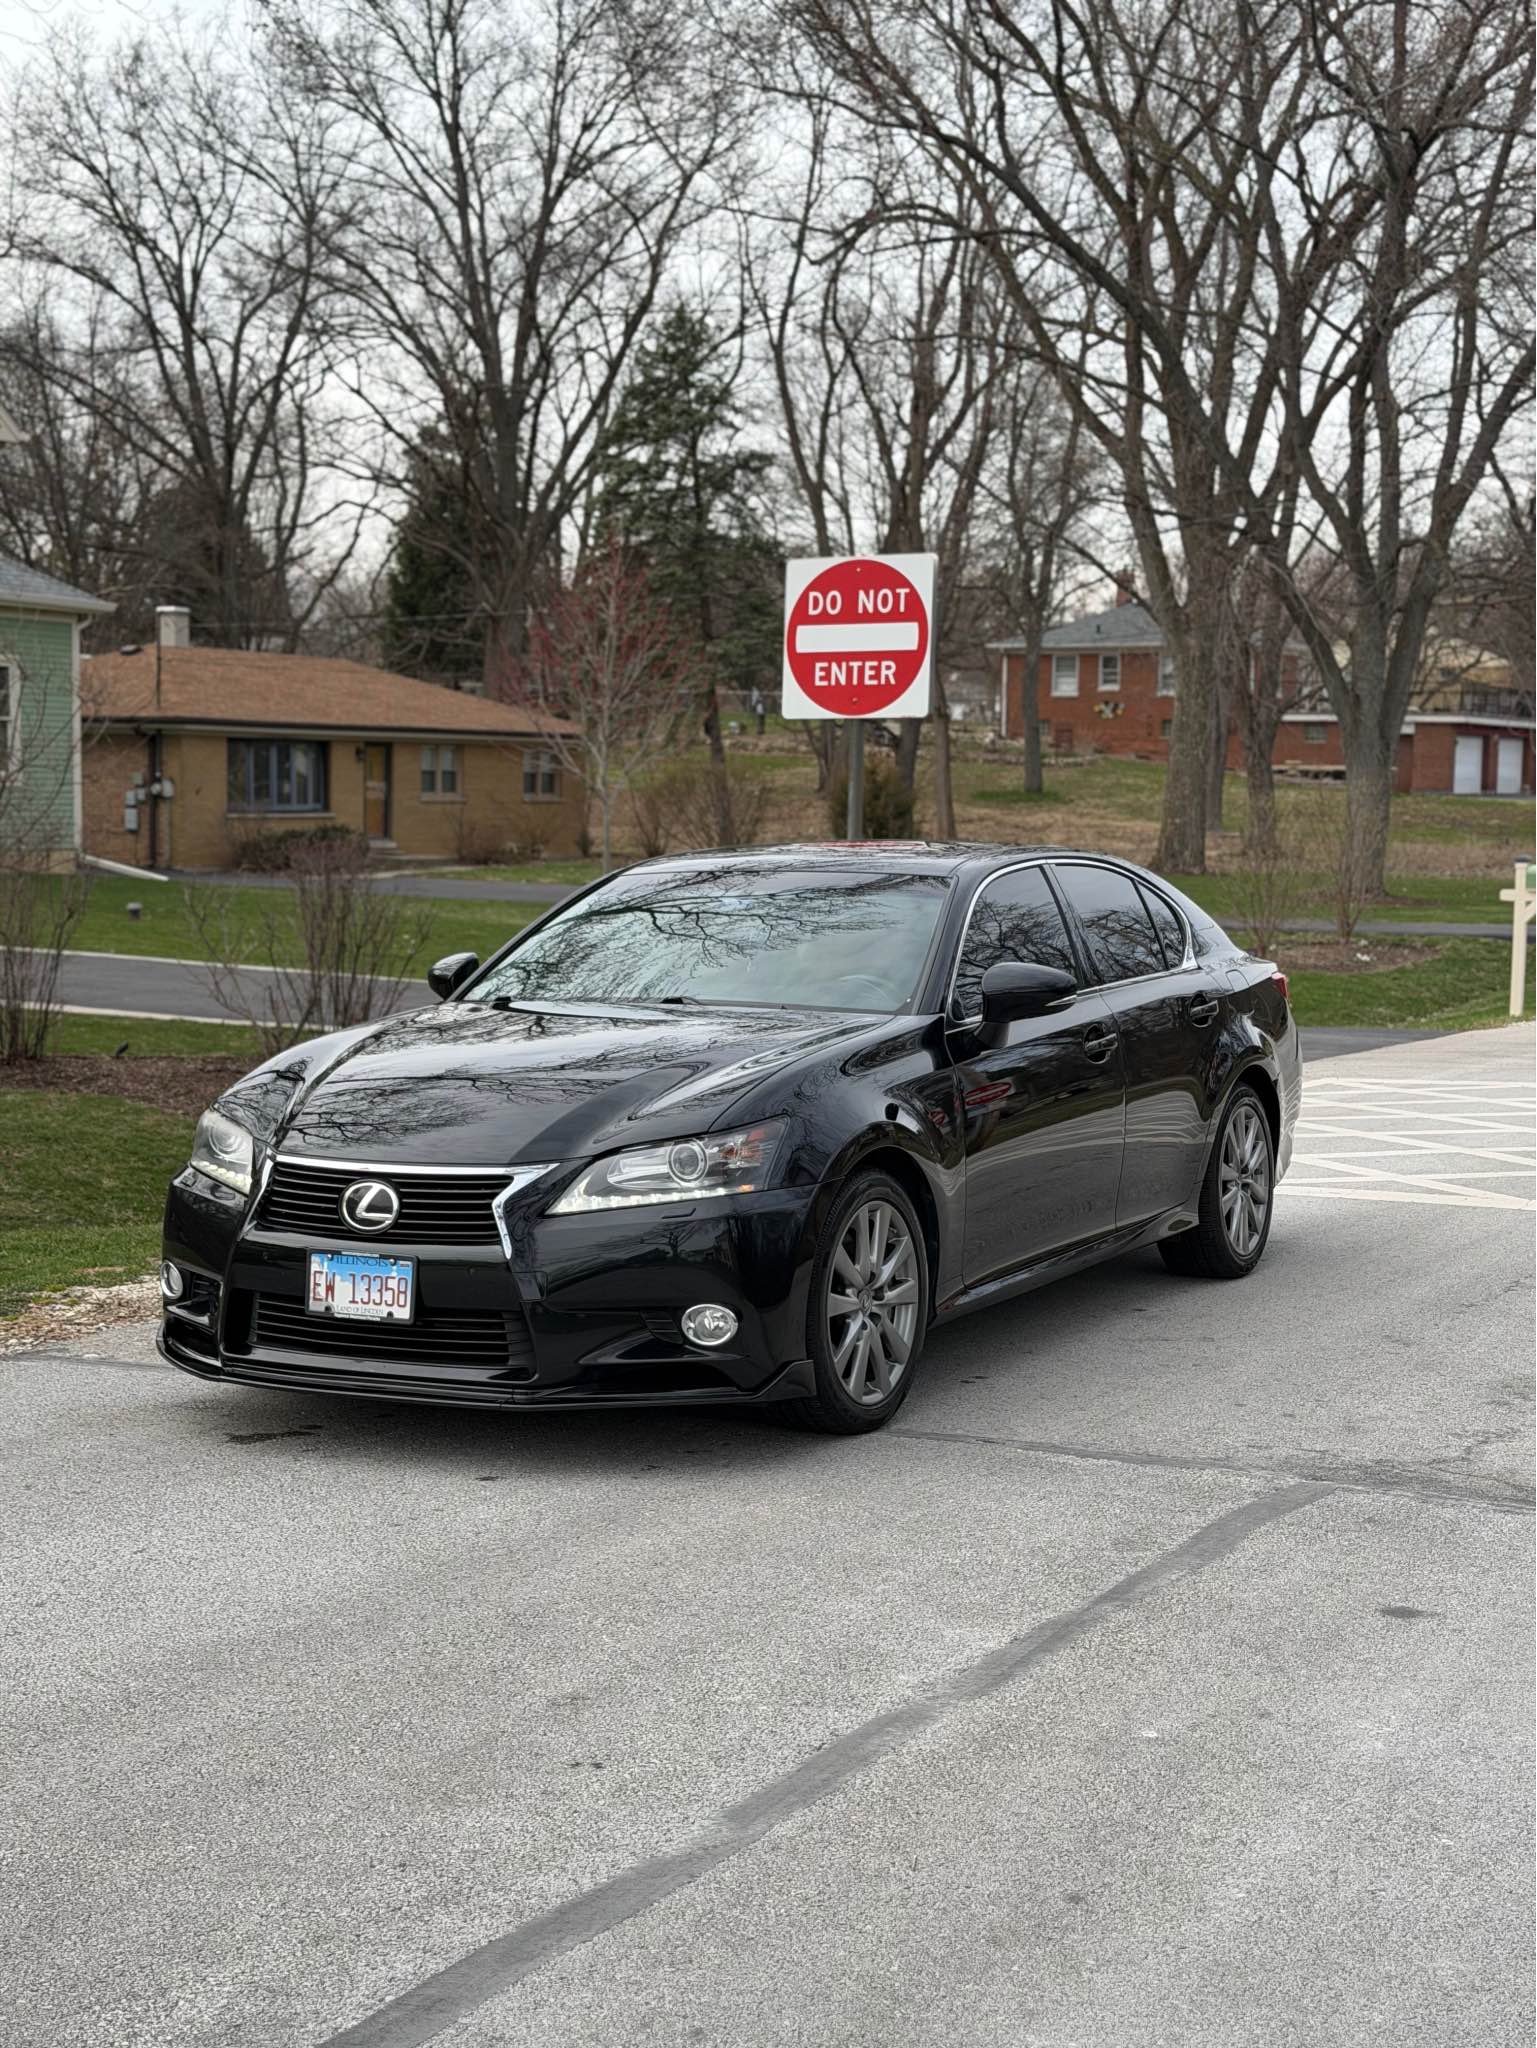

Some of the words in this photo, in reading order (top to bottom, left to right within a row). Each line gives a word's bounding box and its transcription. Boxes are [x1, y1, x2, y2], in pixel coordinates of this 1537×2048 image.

[808, 590, 842, 616] DO
[857, 588, 910, 614] NOT
[814, 660, 897, 687] ENTER
[336, 1256, 389, 1267] ILLINOIS
[312, 1270, 336, 1302] EW
[348, 1273, 409, 1308] 13358
